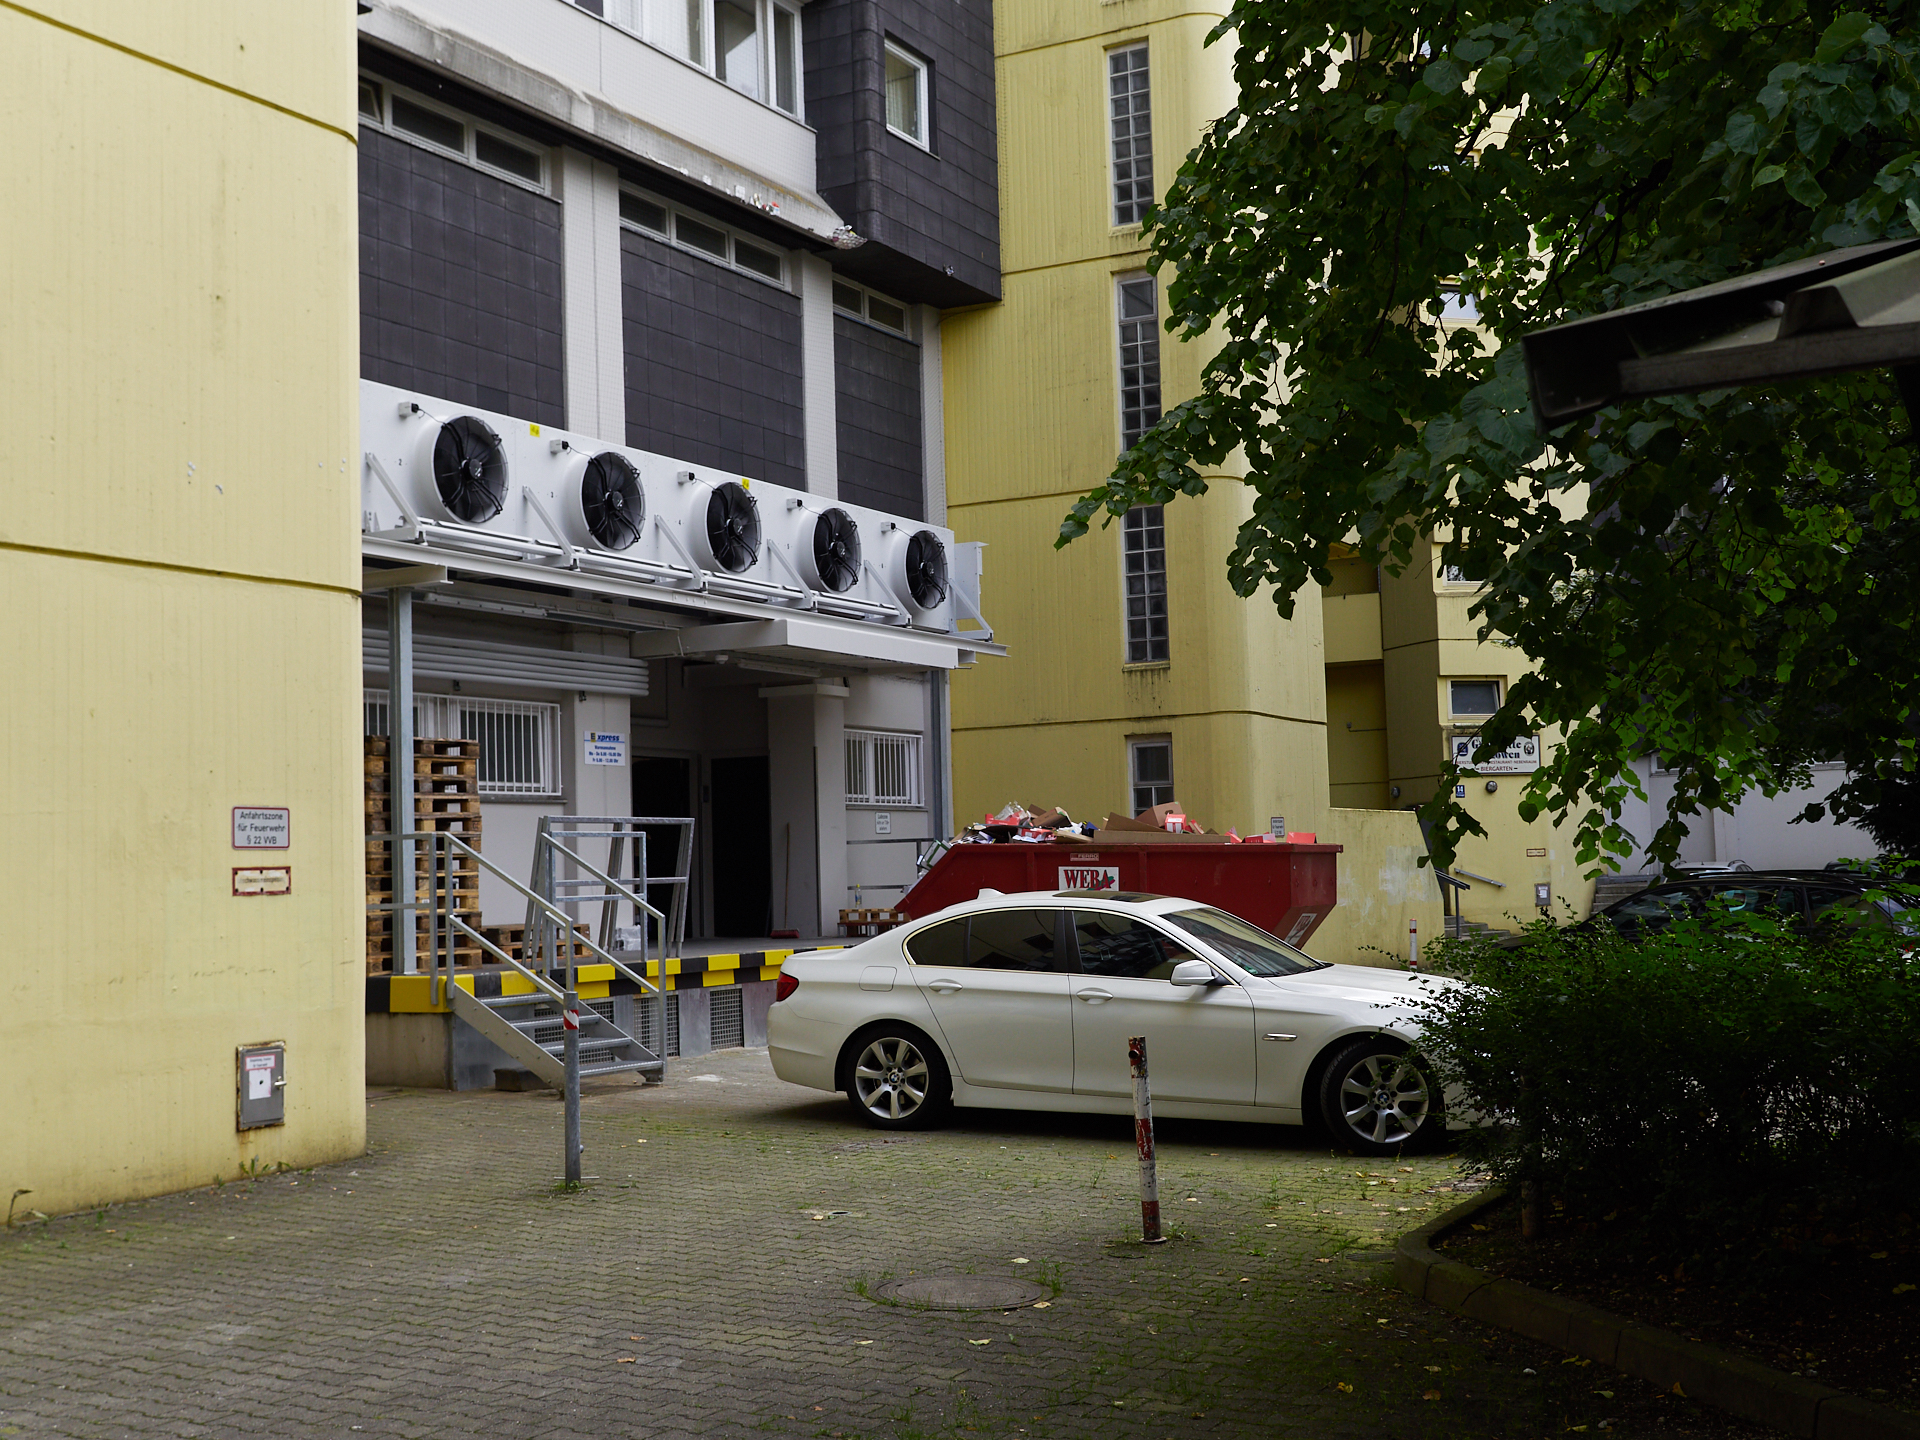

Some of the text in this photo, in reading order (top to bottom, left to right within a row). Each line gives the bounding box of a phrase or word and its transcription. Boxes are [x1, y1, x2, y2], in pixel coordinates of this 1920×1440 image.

[239, 811, 283, 820] Anfahrtszone
[237, 823, 286, 832] für Feuerwehr
[253, 836, 261, 844] 22
[1063, 869, 1112, 889] WEBA
